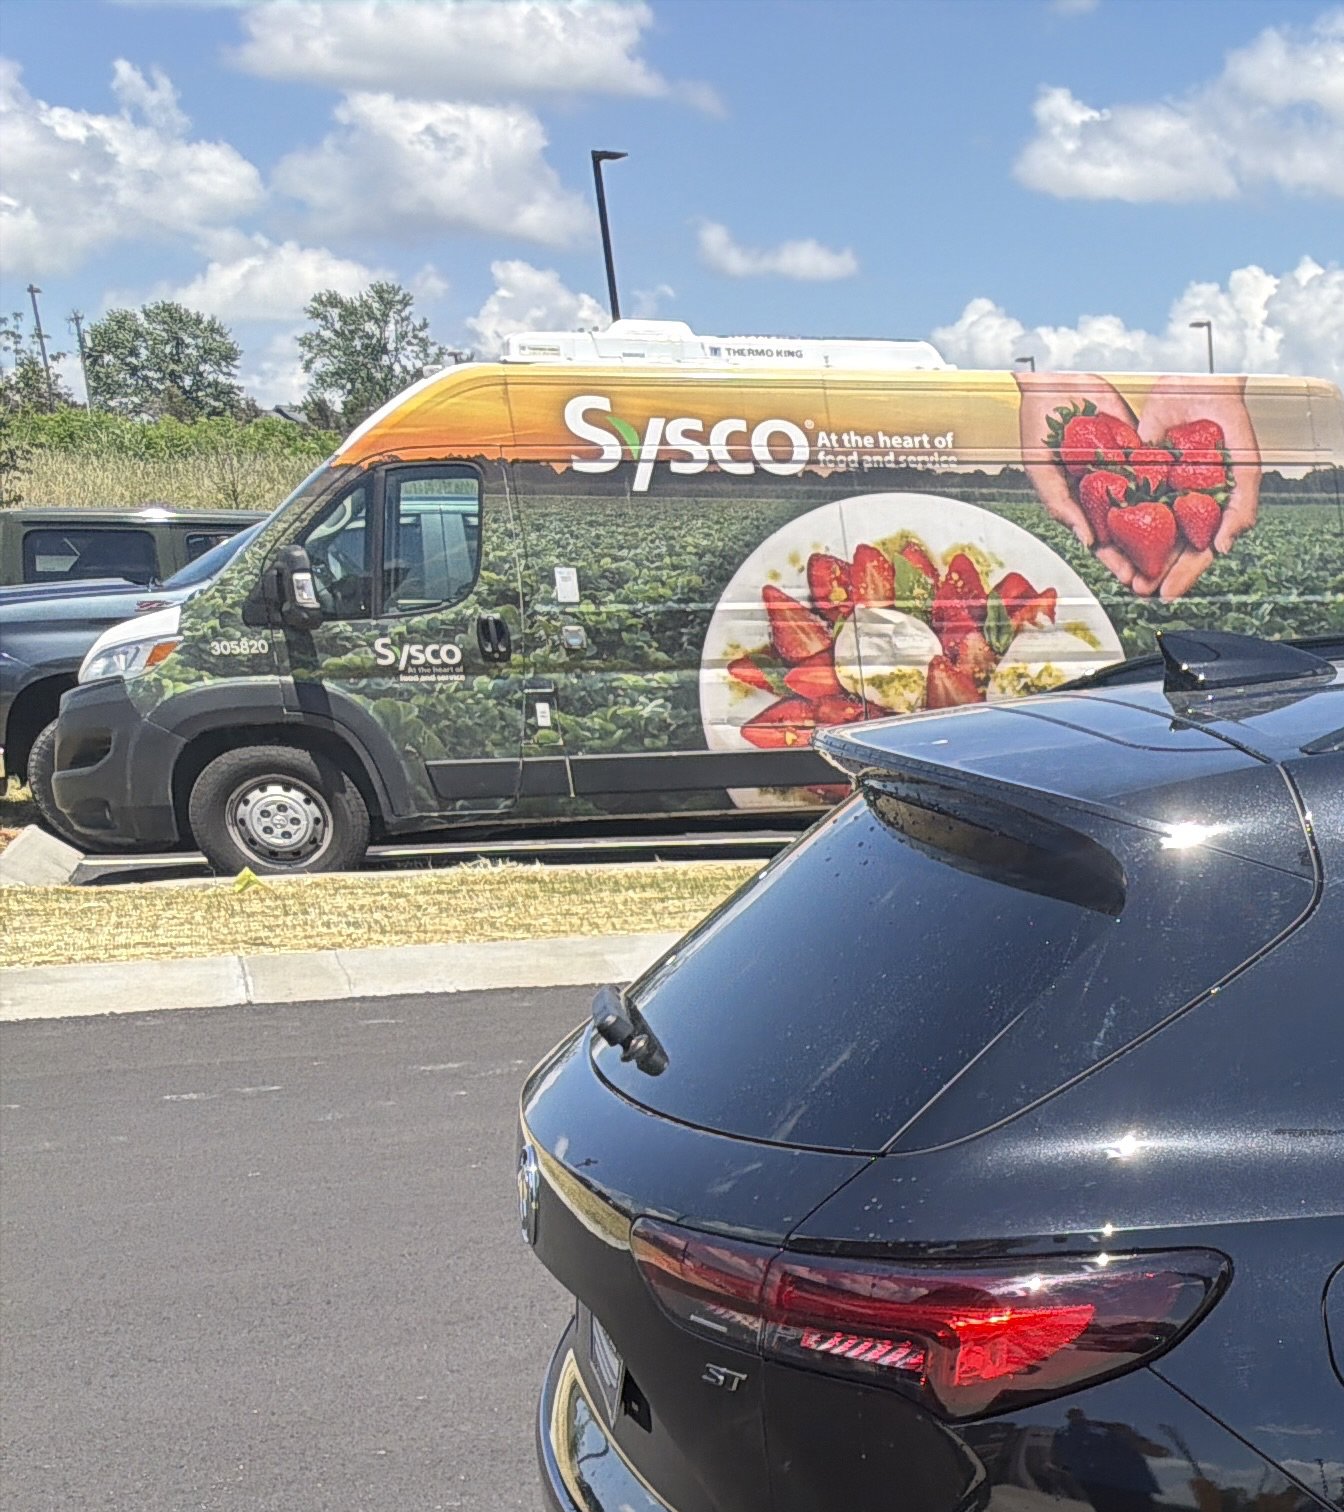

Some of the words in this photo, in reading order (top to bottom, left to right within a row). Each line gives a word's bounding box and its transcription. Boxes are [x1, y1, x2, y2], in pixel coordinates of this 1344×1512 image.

[725, 347, 774, 358] THERMO
[776, 349, 803, 359] KING
[563, 395, 810, 492] Sysco
[817, 431, 839, 448] At
[842, 431, 874, 448] the
[877, 431, 930, 448] heart
[933, 432, 954, 448] of
[817, 451, 859, 468] food
[862, 451, 896, 470] and
[899, 452, 958, 469] service
[210, 639, 269, 656] 305820
[701, 1363, 748, 1392] ST
